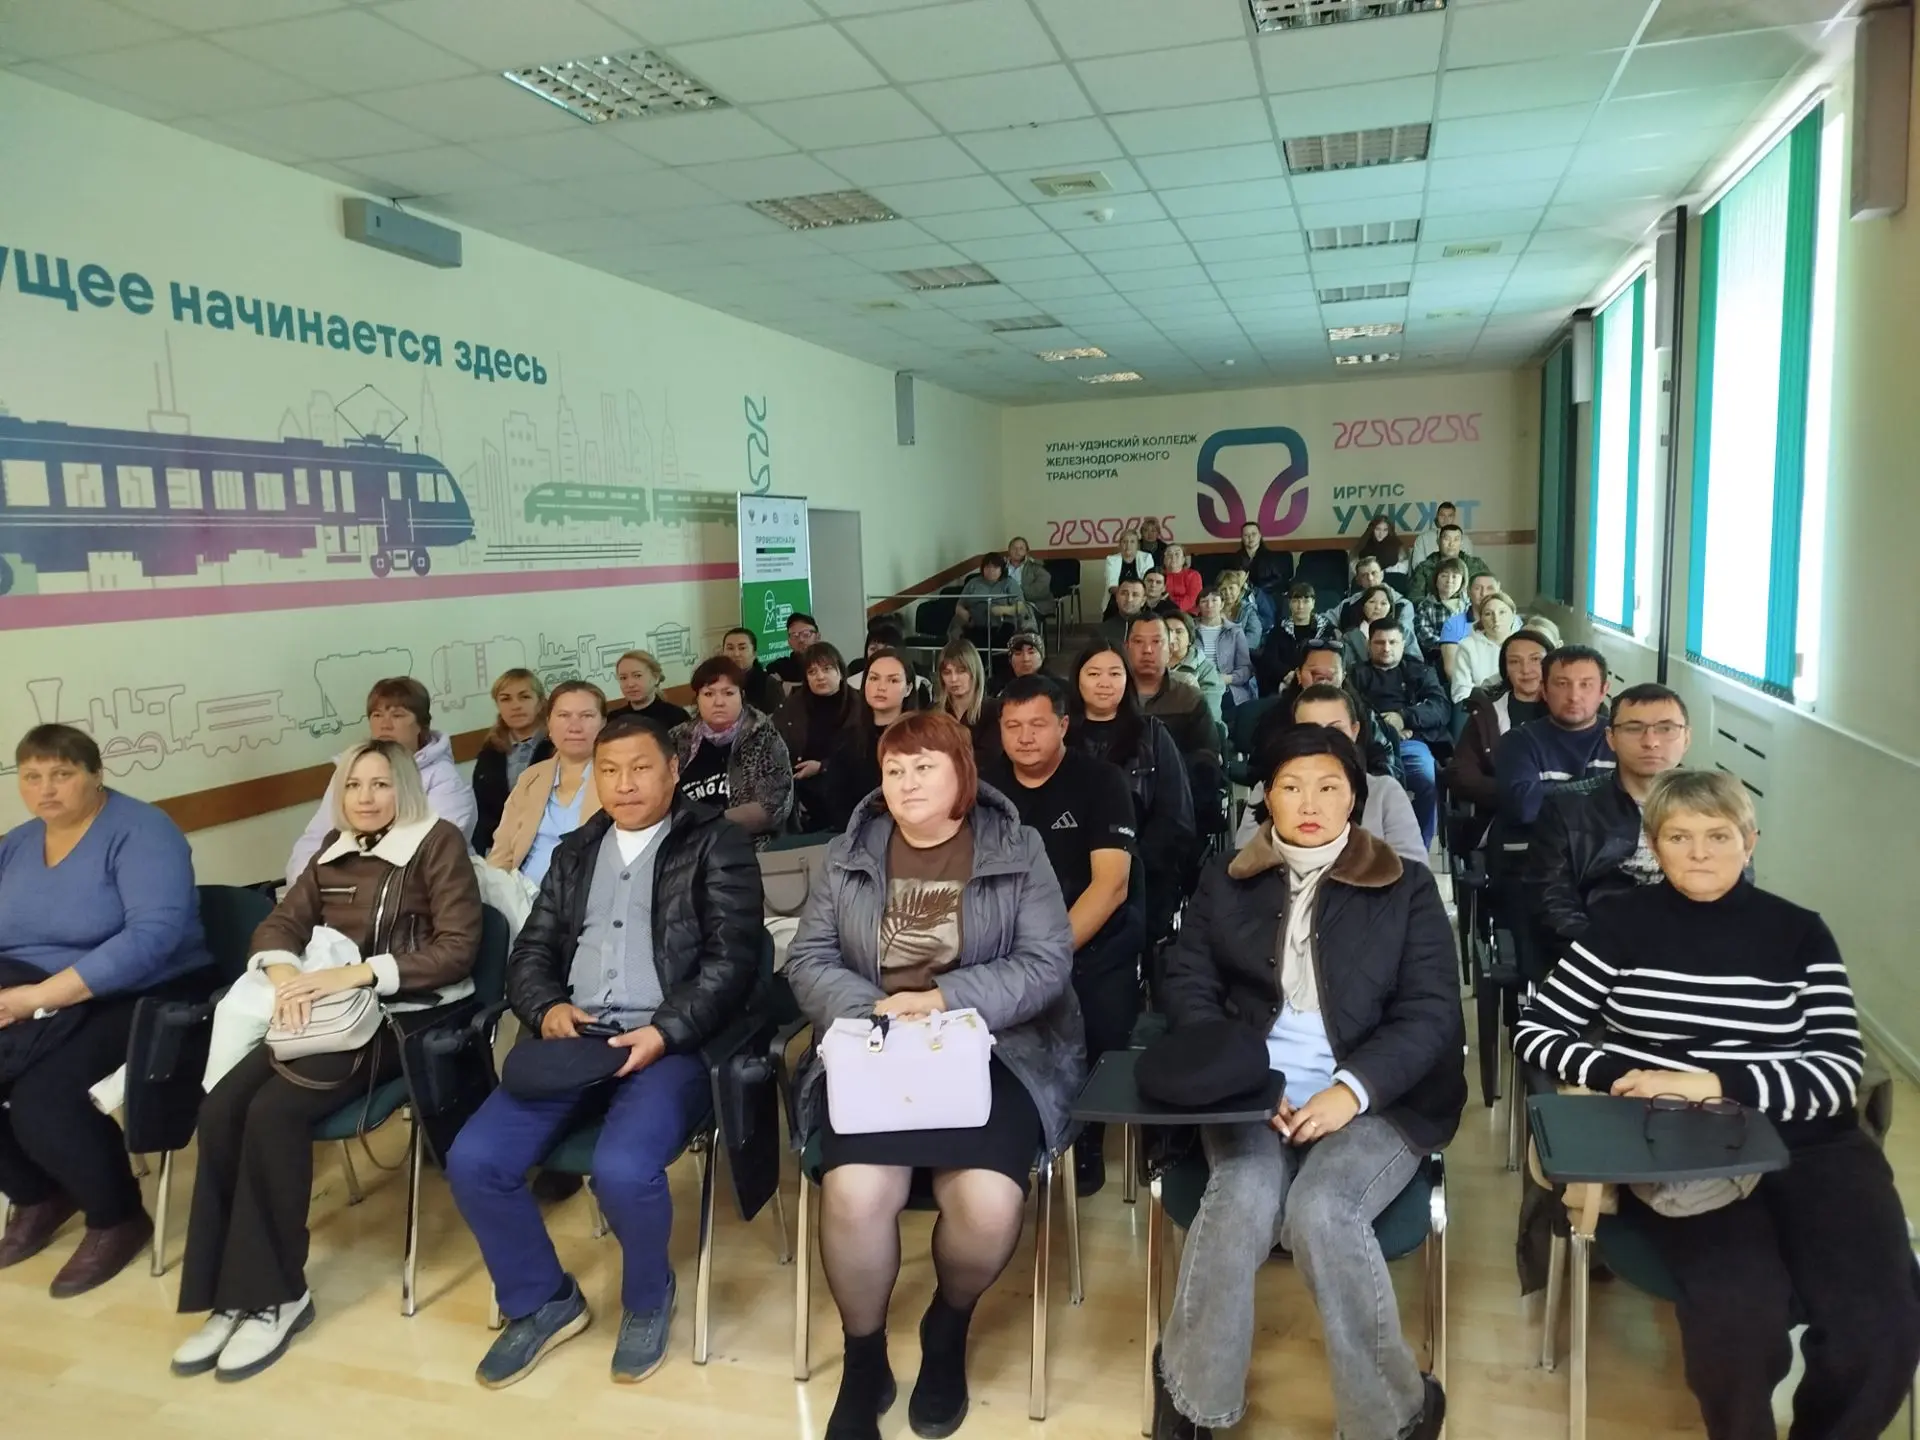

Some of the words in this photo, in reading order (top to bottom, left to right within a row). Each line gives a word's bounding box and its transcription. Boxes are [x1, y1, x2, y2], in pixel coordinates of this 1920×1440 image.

[0, 246, 154, 315] щее
[169, 281, 443, 367] начинается
[454, 340, 548, 385] здесь
[1045, 434, 1140, 452] УЛАН-УДЭНСКИЙ
[1142, 433, 1198, 447] КОЛЛЕДЖ
[1046, 450, 1171, 467] ЖЕЛЕЗНОДОРОЖНОГО
[1046, 468, 1119, 481] ТРАНСПОРТА
[1333, 483, 1405, 500] ИРГУПС
